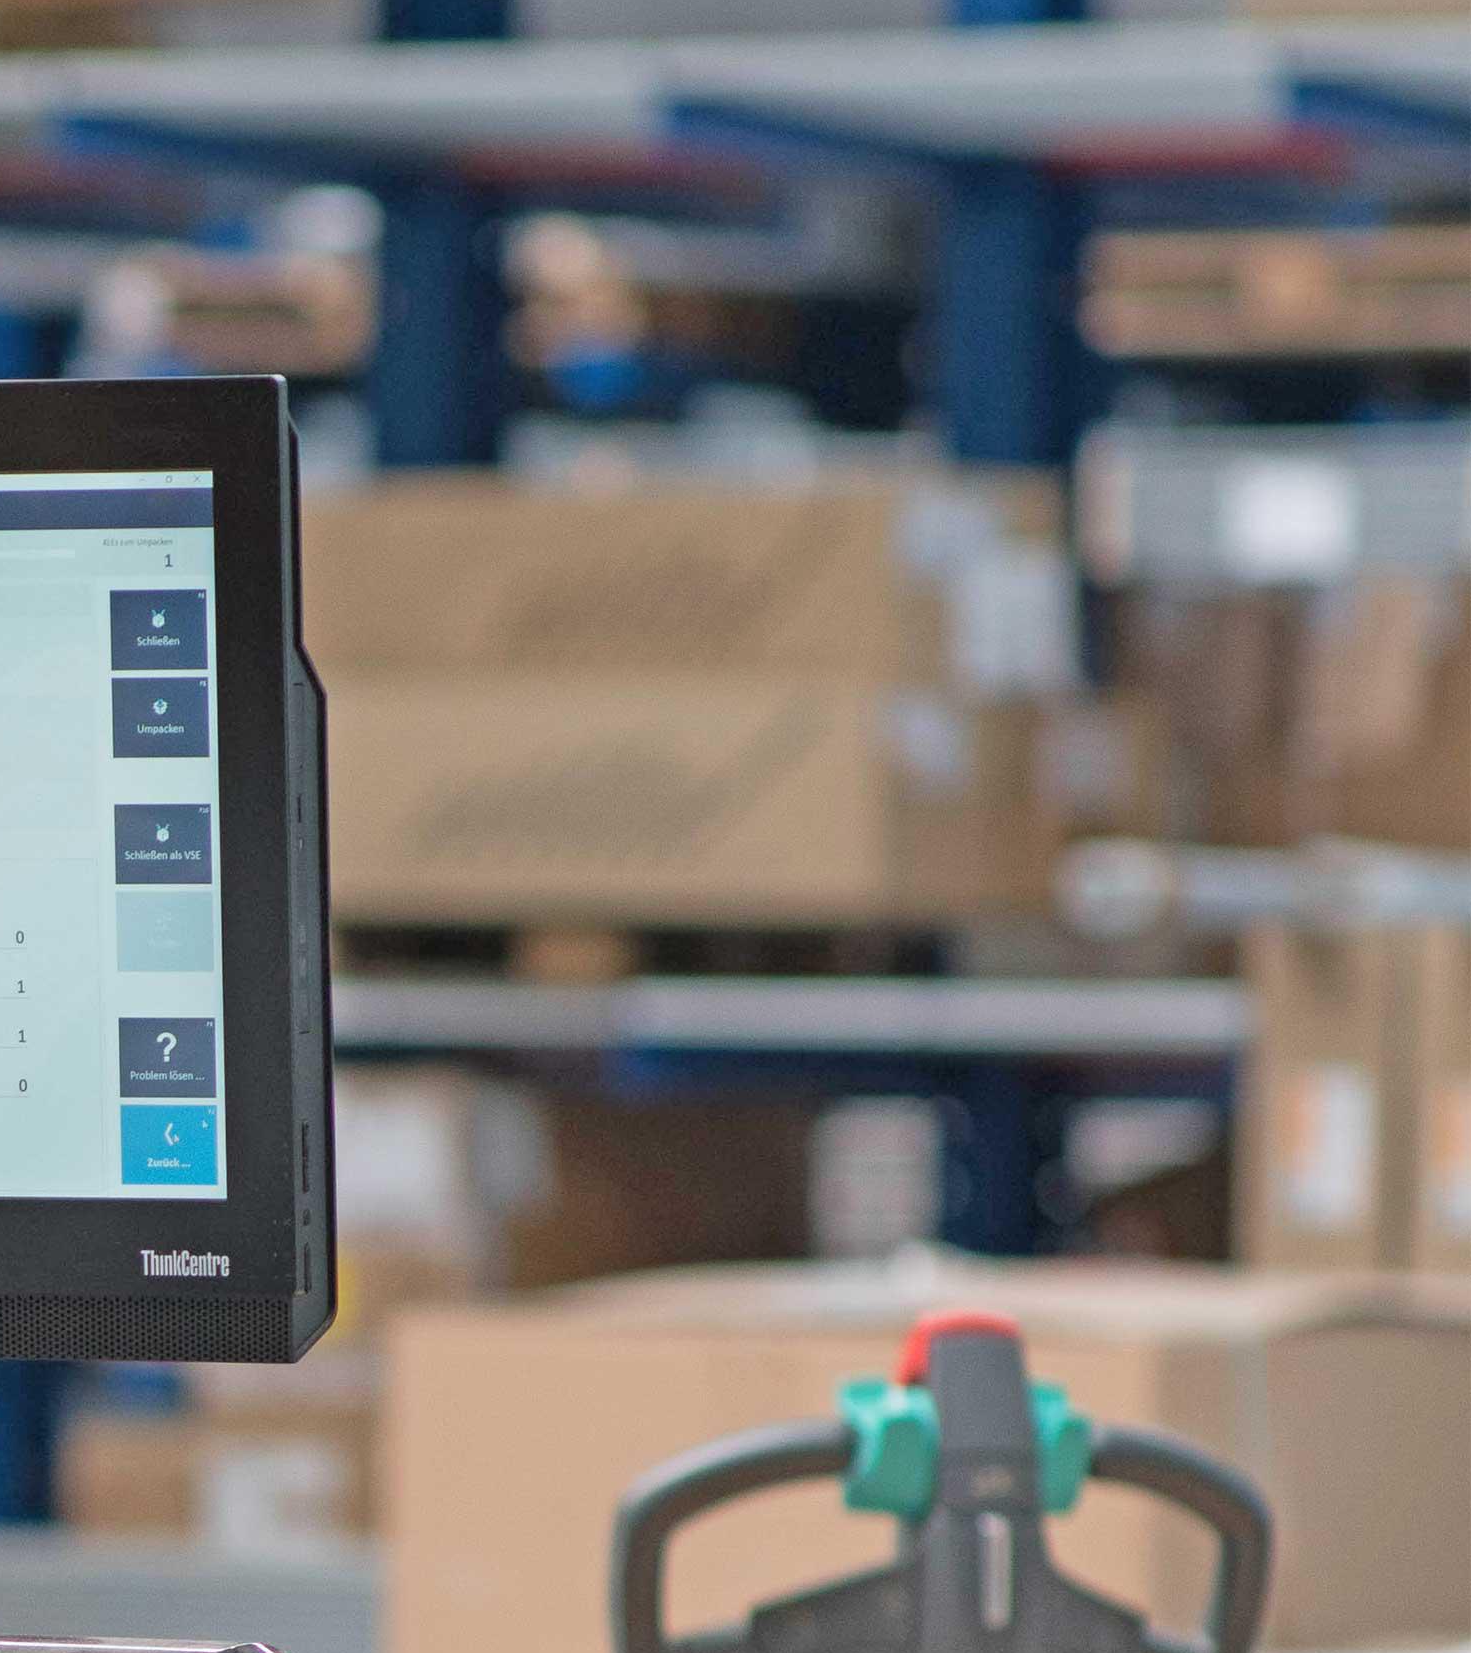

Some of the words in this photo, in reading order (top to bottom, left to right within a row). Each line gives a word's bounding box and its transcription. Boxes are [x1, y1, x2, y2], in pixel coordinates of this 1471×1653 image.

[165, 554, 172, 567] 1
[137, 636, 180, 646] Schließen
[137, 724, 185, 735] Umpacken
[124, 850, 168, 861] Schließen
[170, 850, 183, 860] als
[184, 850, 202, 860] VSE
[16, 931, 24, 944] 0
[18, 980, 25, 993] 1
[19, 1030, 26, 1042] 1
[130, 1071, 169, 1081] Problem
[170, 1071, 194, 1081] lösen
[19, 1079, 27, 1092] 0
[146, 1158, 180, 1168] Zurück
[140, 1249, 230, 1277] ThinkCentre
